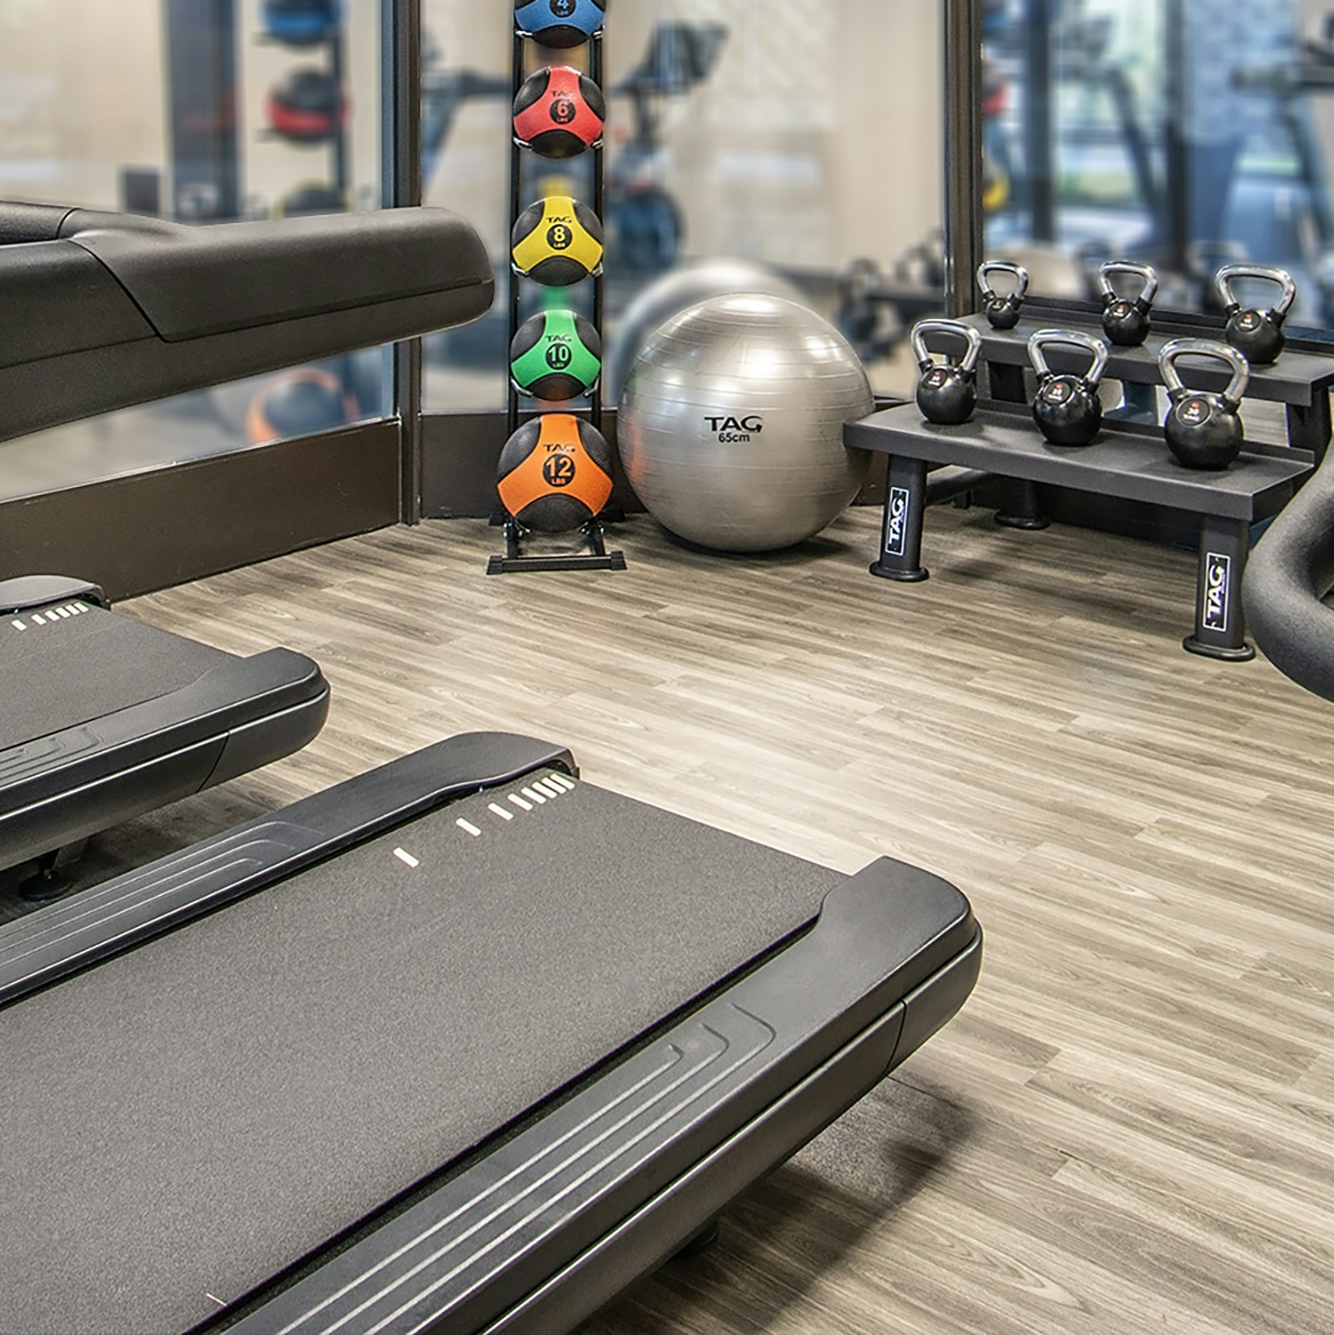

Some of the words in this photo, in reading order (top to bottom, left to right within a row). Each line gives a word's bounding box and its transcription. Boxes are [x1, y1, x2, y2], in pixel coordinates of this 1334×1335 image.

[557, 100, 569, 117] 6
[553, 226, 565, 242] 8
[548, 346, 569, 362] 10
[703, 415, 764, 433] TAG
[718, 432, 750, 443] 65cm
[546, 456, 572, 477] 12
[888, 498, 905, 545] TAG
[1207, 564, 1225, 619] TAG
